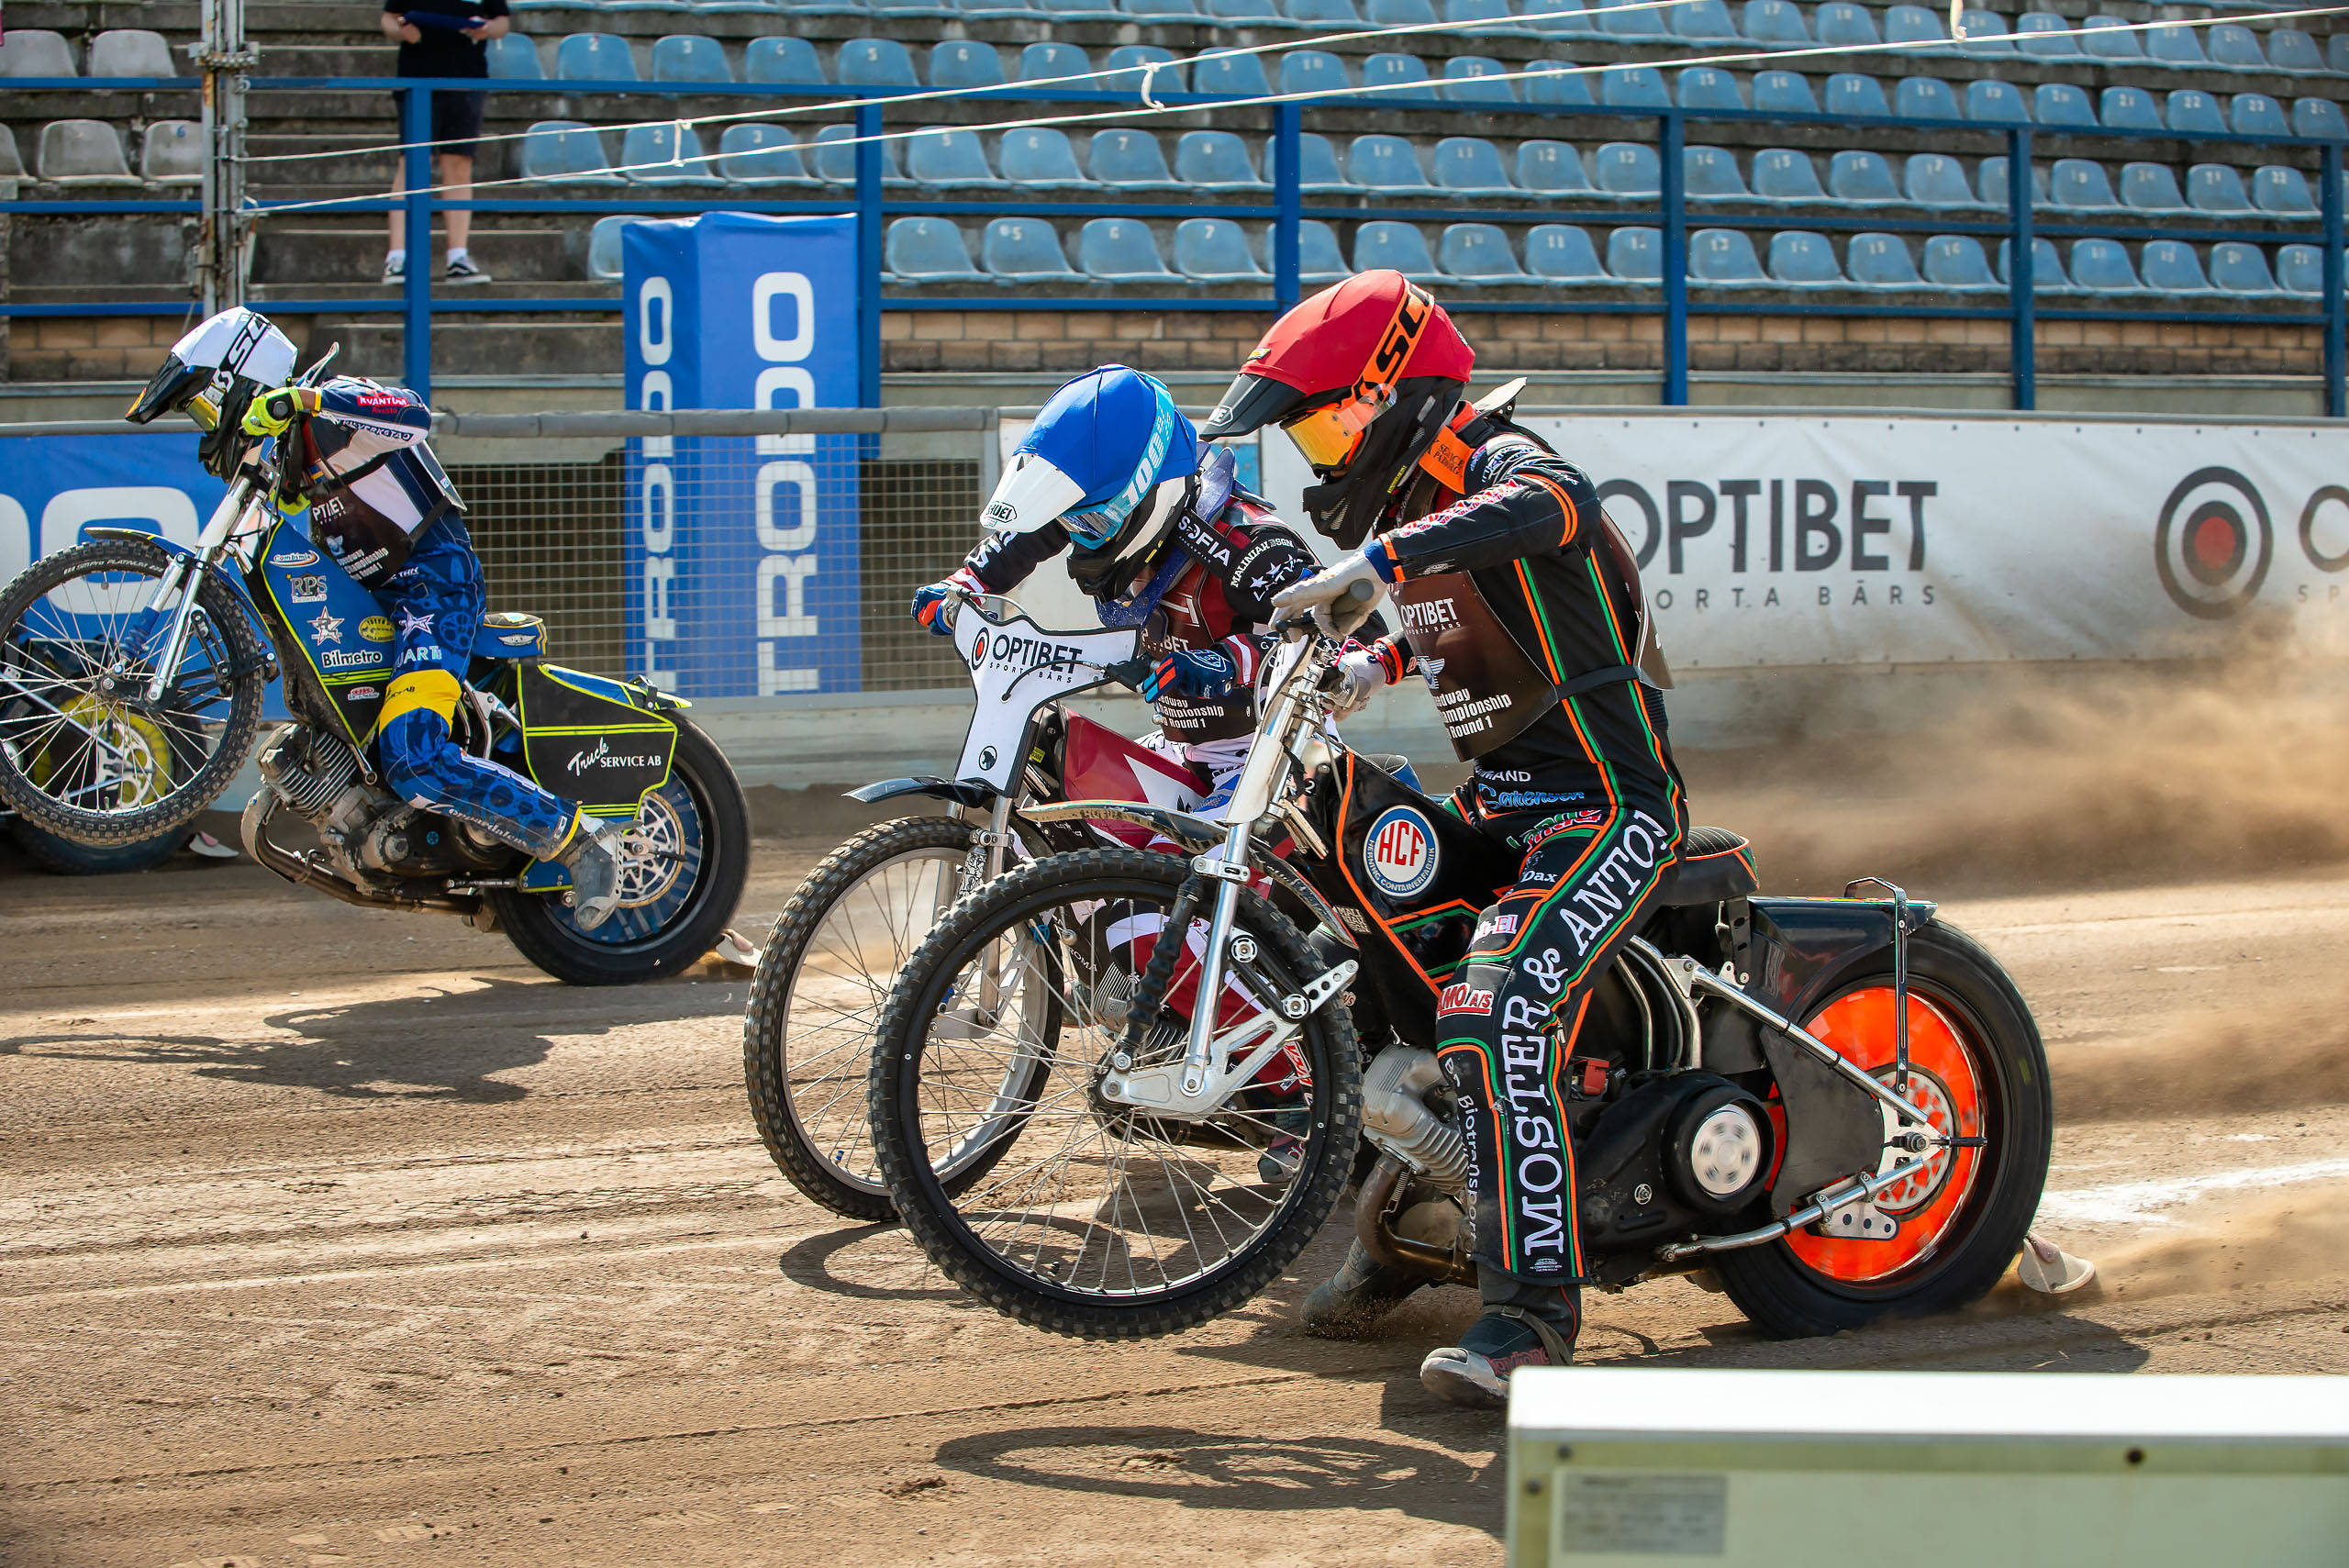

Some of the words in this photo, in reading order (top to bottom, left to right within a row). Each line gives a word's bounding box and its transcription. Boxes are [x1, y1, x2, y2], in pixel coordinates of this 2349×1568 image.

[589, 38, 598, 50] 2
[683, 40, 692, 53] 3
[776, 43, 785, 55] 4
[868, 48, 877, 61] 5
[958, 49, 967, 61] 6
[1047, 49, 1056, 62] 7
[1387, 60, 1404, 72] 11
[1772, 76, 1787, 88] 16
[2184, 95, 2200, 108] 22
[176, 127, 185, 138] 6
[653, 130, 662, 143] 2
[752, 130, 762, 143] 3
[1118, 136, 1129, 150] 7
[1852, 157, 1868, 171] 16
[1013, 227, 1022, 240] 5
[1110, 227, 1119, 239] 6
[1205, 226, 1215, 239] 7
[1548, 235, 1564, 248] 11
[752, 272, 819, 695] TRODO
[1598, 479, 1938, 574] OPTIBET
[1178, 516, 1230, 567] SOFIA
[290, 575, 328, 596] RPS
[1656, 588, 1780, 610] ORTA
[1400, 597, 1458, 628] OPTIBET
[321, 650, 383, 668] Bilmetro
[992, 634, 1083, 674] OPTIBET
[989, 662, 1031, 677] SPORT
[1169, 717, 1198, 728] Round
[1200, 718, 1207, 728] 1
[1449, 717, 1485, 739] Round
[1485, 716, 1493, 728] 1
[567, 736, 608, 776] Truck
[600, 755, 645, 768] SERVICE
[647, 755, 662, 766] AB
[1378, 821, 1424, 866] HCF
[1520, 871, 1558, 883] Dax
[1523, 948, 1568, 995] &
[1469, 992, 1492, 1008] A/S
[1501, 995, 1564, 1256] MOSTER
